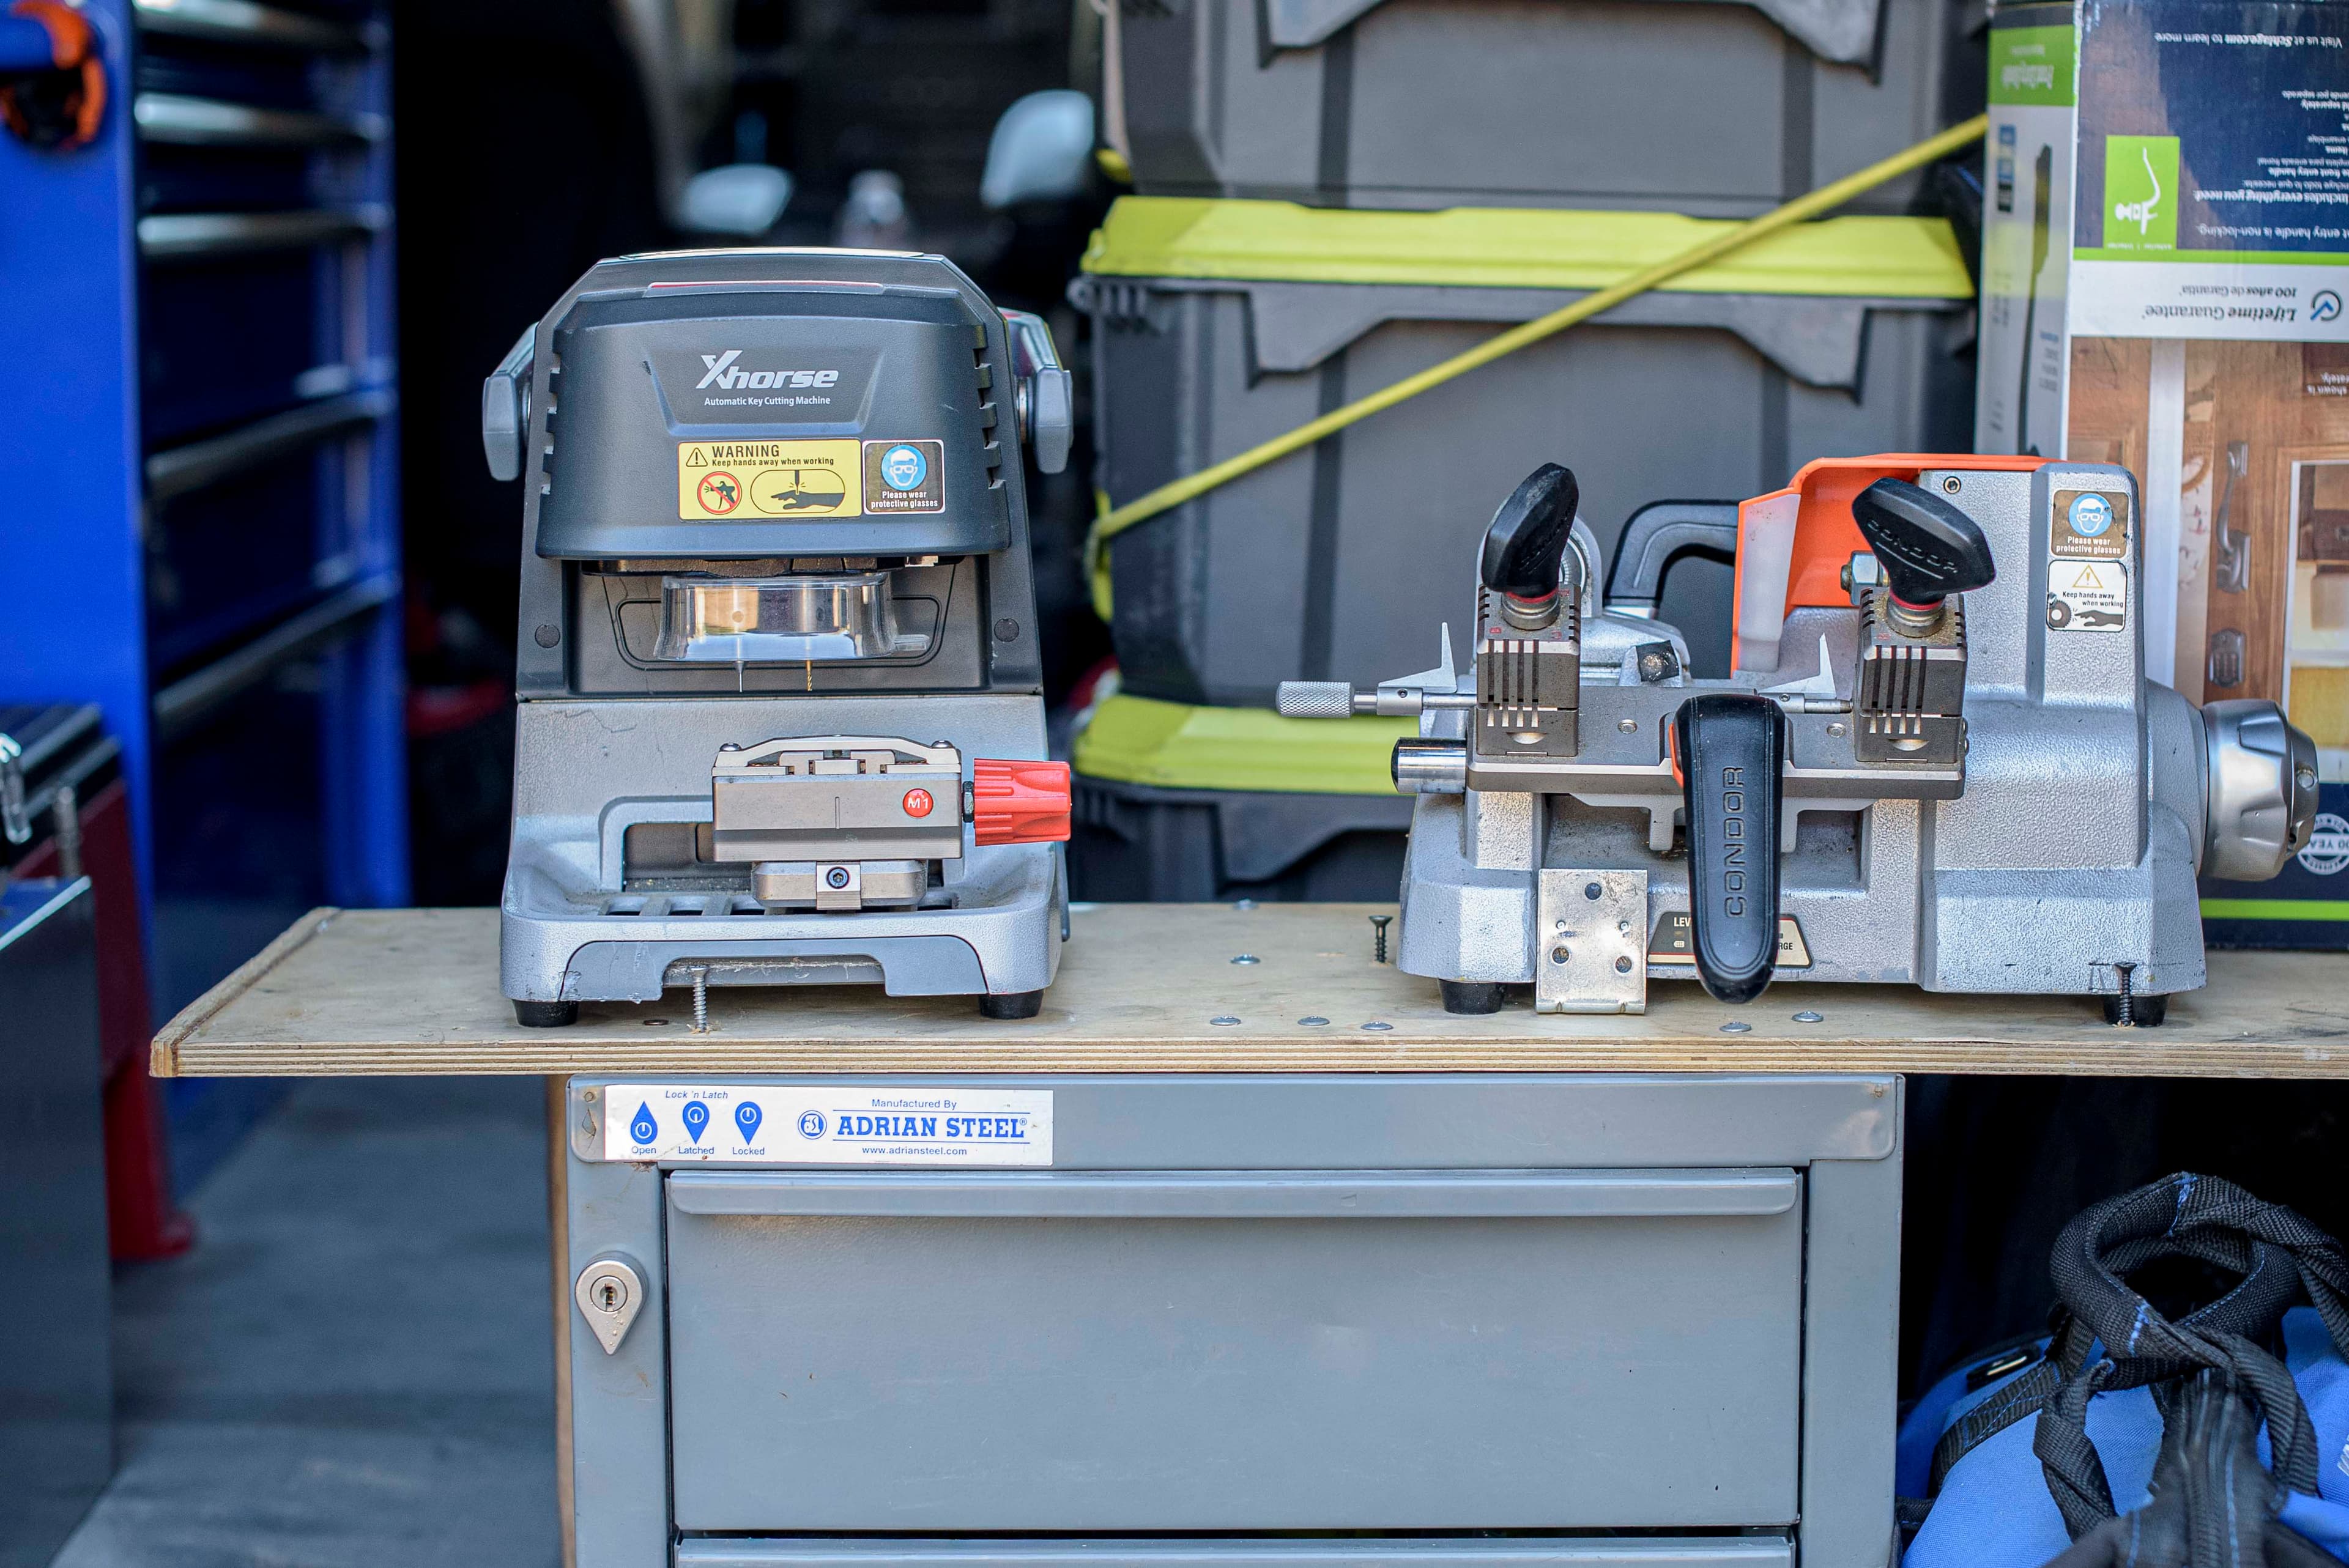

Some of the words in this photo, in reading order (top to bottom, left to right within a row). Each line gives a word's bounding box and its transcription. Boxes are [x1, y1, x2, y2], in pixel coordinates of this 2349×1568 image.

[2183, 33, 2210, 46] learn
[2210, 34, 2223, 45] to
[2224, 33, 2293, 48] Schlage.com
[2293, 35, 2304, 46] at
[2306, 36, 2318, 46] us
[2320, 37, 2342, 48] Visit
[2224, 189, 2245, 201] you
[2246, 189, 2303, 204] everything
[2263, 227, 2273, 240] is
[2274, 227, 2310, 240] handle
[2313, 225, 2340, 239] entry
[2230, 286, 2245, 297] de
[2275, 287, 2297, 298] 100
[2227, 306, 2297, 322] Lifetime
[696, 350, 839, 389] Xhorse
[704, 397, 747, 406] Automatic
[748, 398, 763, 407] Key
[764, 396, 795, 407] Cutting
[795, 396, 831, 405] Machine
[711, 444, 780, 458] WARNING
[712, 459, 731, 467] Keep
[881, 490, 907, 499] Please
[870, 500, 908, 509] protective
[910, 499, 938, 509] glasses
[2068, 536, 2091, 545] Please
[2056, 544, 2092, 553] protective
[2093, 546, 2121, 555] glasses
[2062, 591, 2078, 599] Keep
[1723, 767, 1746, 918] CONDOR
[665, 1090, 688, 1099] Lock
[702, 1090, 729, 1100] Latch
[872, 1098, 940, 1109] Manufactured
[944, 1100, 957, 1111] By
[837, 1116, 937, 1137] ADRIAN
[631, 1146, 657, 1155] Open
[678, 1145, 714, 1155] Latched
[732, 1147, 765, 1156] Locked
[861, 1145, 968, 1156] www.adriansteel.com
